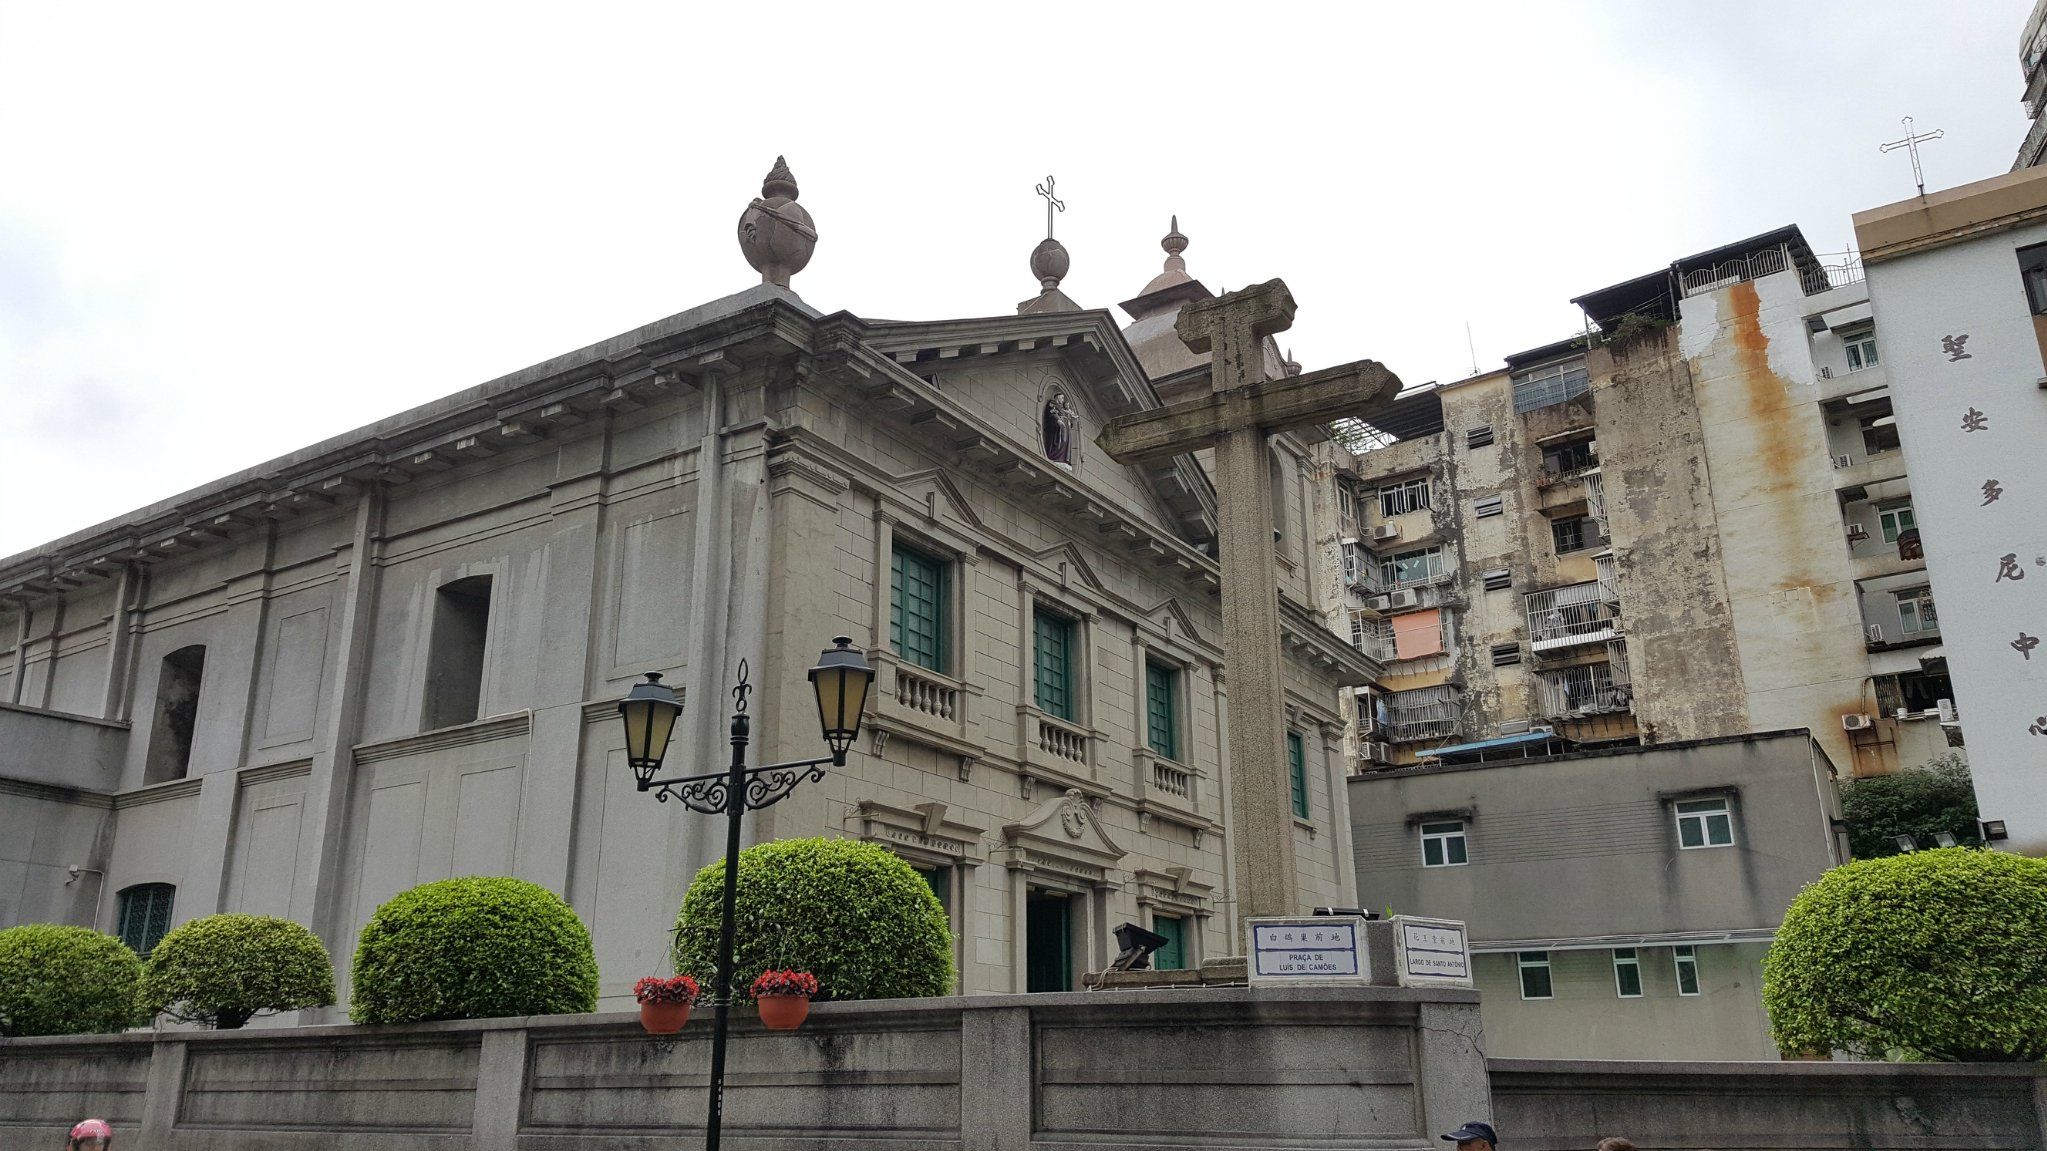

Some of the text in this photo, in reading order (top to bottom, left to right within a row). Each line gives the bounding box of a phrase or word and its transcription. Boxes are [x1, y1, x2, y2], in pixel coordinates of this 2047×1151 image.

[1270, 932, 1341, 942] 白鴿巢前地
[1289, 954, 1312, 962] PRAÇA
[1410, 958, 1424, 966] LARGO
[1279, 963, 1293, 971] LUÍS
[1309, 963, 1337, 971] CAMÕES
